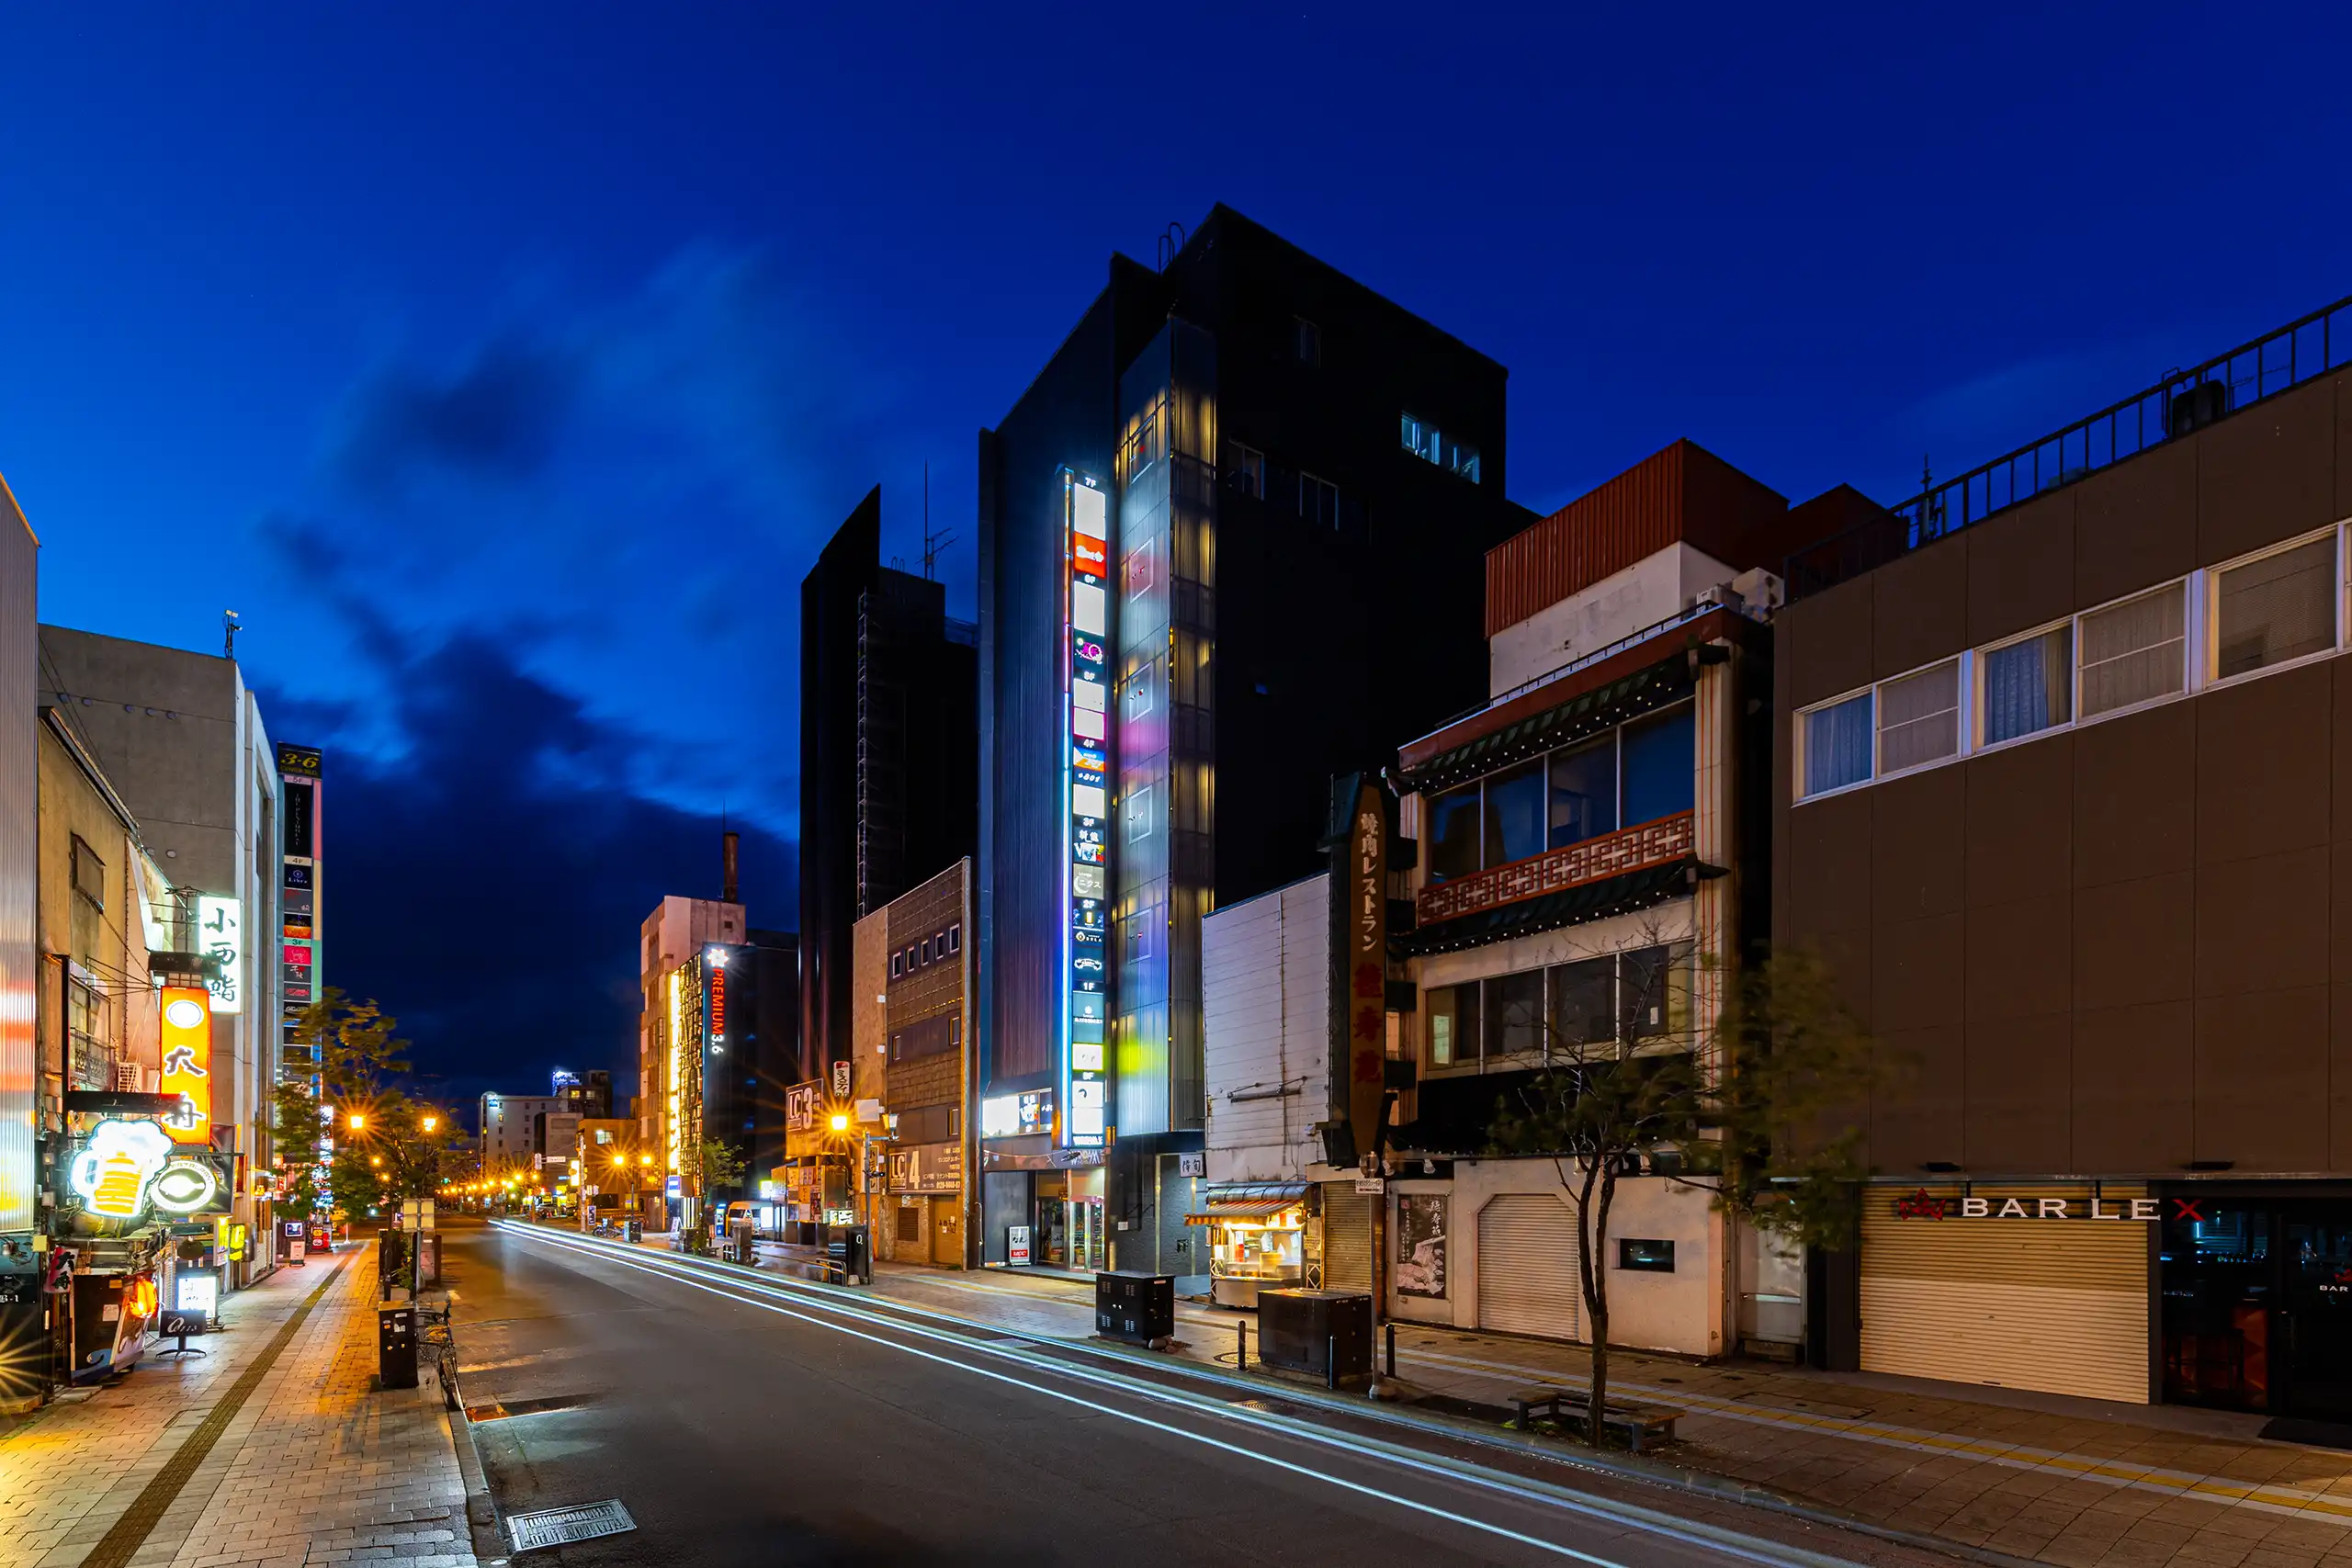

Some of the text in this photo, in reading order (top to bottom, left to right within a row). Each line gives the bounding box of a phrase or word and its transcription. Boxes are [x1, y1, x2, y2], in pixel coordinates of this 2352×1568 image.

[711, 968, 725, 1035] PREMIUM
[1083, 982, 1095, 991] 1F
[789, 1093, 801, 1119] LC
[803, 1087, 813, 1130] 3
[891, 1155, 905, 1179] LC
[909, 1150, 921, 1190] 4
[1962, 1198, 2068, 1219] BAR
